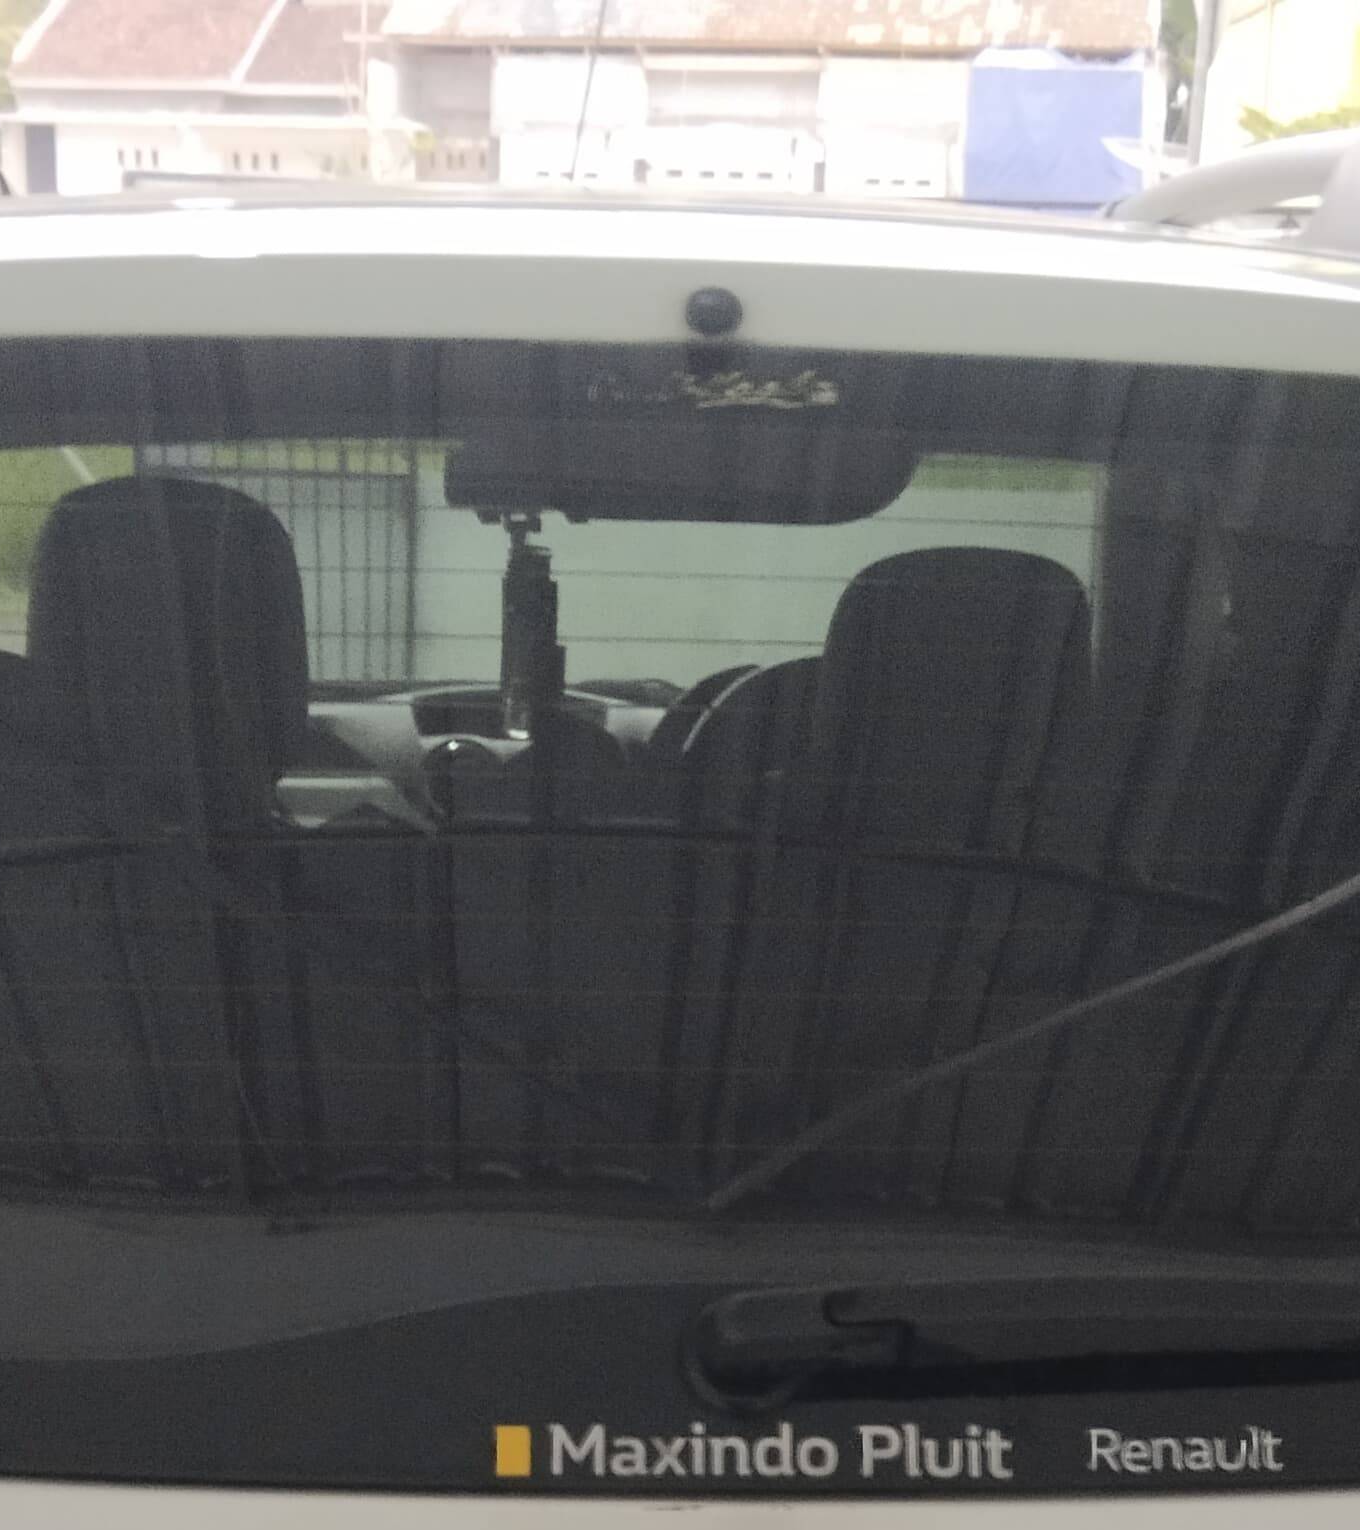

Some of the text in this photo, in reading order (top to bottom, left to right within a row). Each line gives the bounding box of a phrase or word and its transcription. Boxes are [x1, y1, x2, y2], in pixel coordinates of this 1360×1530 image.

[548, 1421, 1014, 1479] Maxindo Pluit
[1088, 1426, 1284, 1473] Renault
